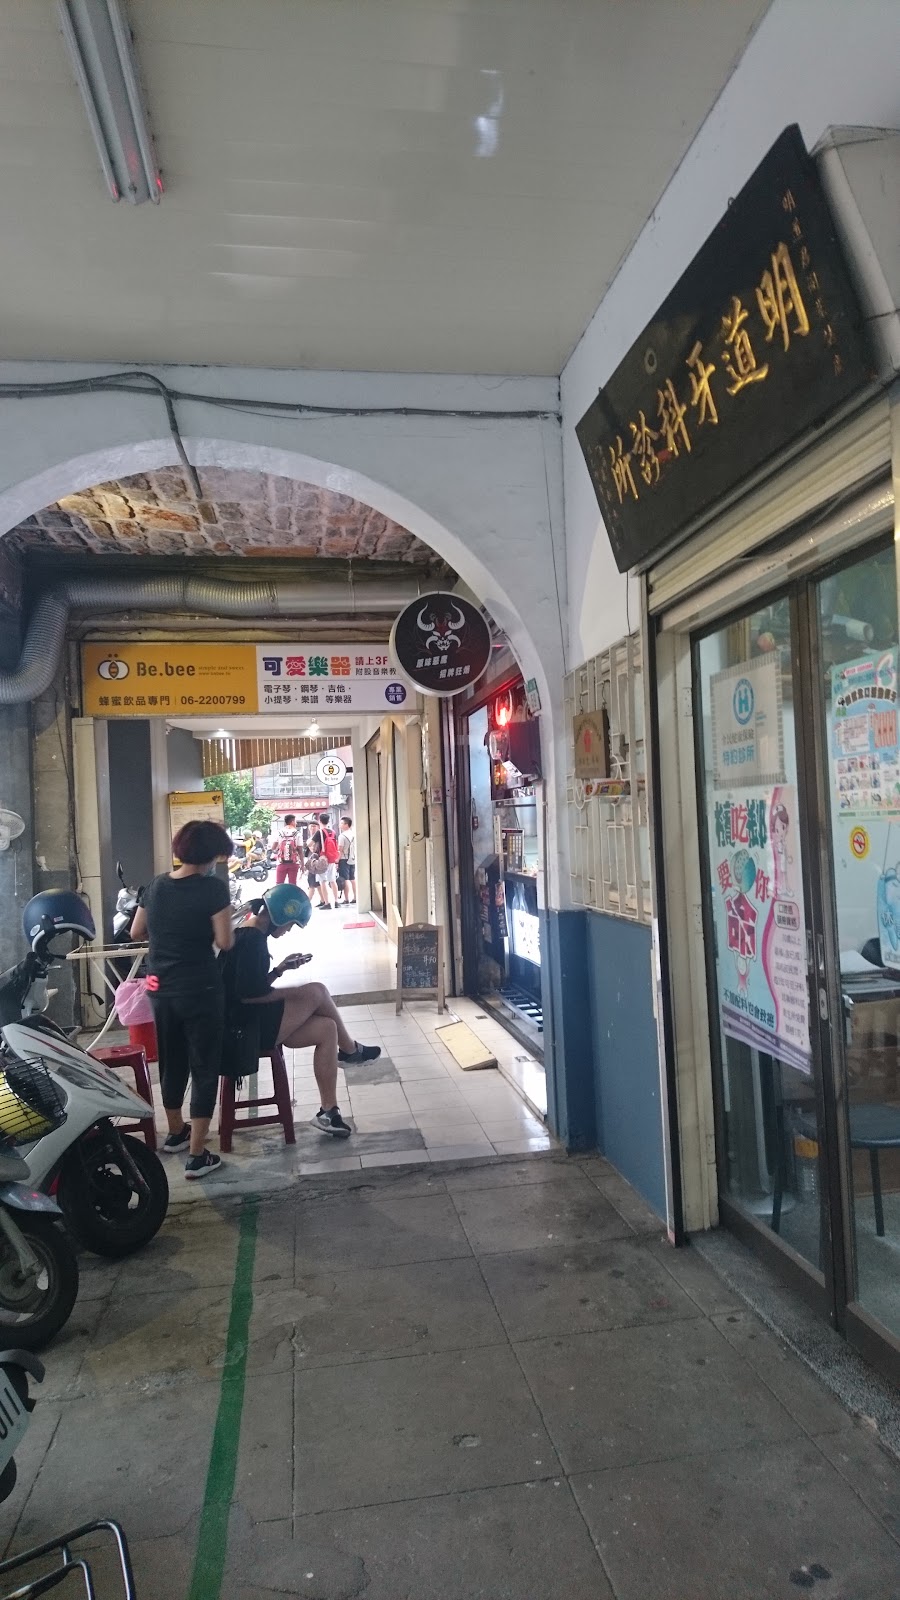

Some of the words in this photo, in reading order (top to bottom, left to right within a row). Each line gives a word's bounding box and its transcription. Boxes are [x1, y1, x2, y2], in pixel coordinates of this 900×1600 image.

[608, 242, 810, 504] 明道牙科診所
[262, 656, 352, 677] 可愛樂器
[355, 656, 388, 666] 請上3F
[136, 662, 196, 677] Be.bee
[355, 667, 399, 676] 附設音樂教
[98, 696, 170, 706] 蜂蜜飲品專門
[181, 695, 246, 705] 06-2200799
[723, 987, 775, 1029] 不加配料也會致癌
